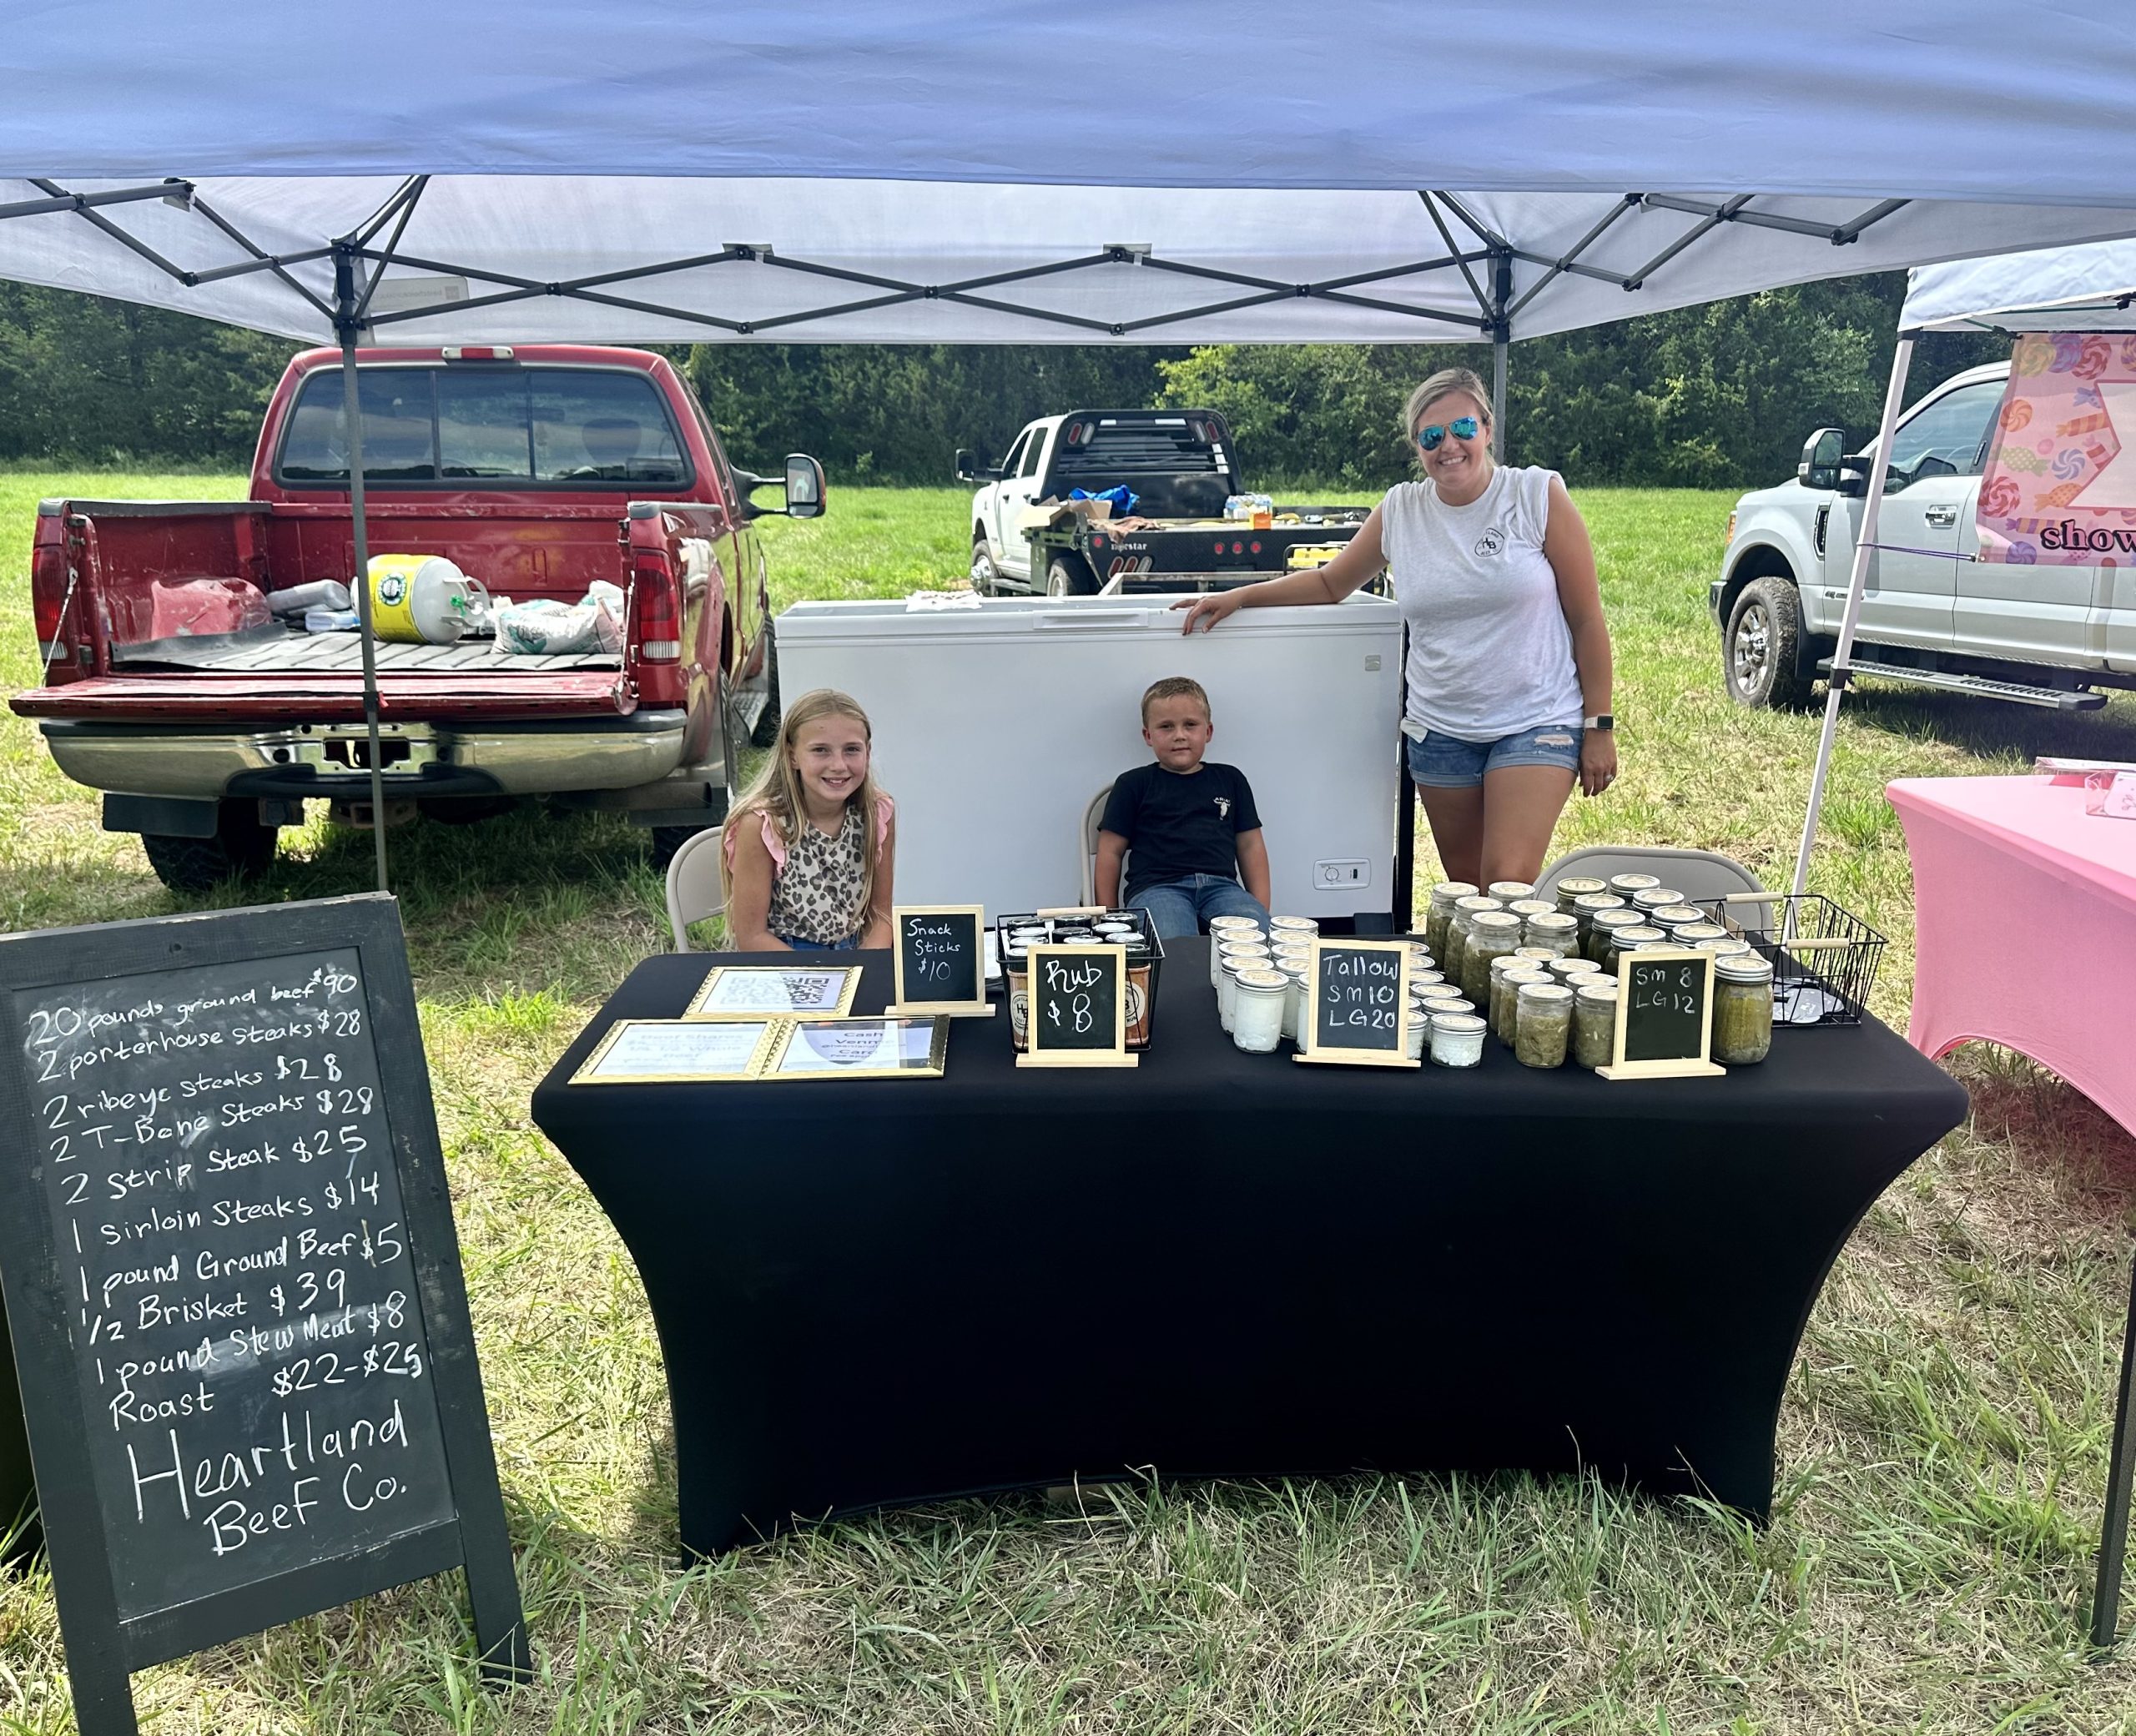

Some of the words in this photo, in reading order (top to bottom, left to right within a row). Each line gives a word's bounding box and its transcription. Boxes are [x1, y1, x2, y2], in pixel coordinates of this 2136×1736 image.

[906, 918, 952, 937] Snack
[914, 938, 961, 956] Sticks
[918, 957, 951, 982] $10
[1045, 959, 1102, 994] Rub
[1322, 954, 1398, 980] Tallow
[1679, 967, 1693, 988] 8
[28, 1008, 82, 1047] 20
[88, 999, 164, 1038] pounds
[173, 989, 257, 1028] ground
[271, 982, 317, 1001] beef
[1673, 993, 1695, 1014] 12
[38, 1049, 62, 1083] 2
[69, 1031, 223, 1080] porterhouse
[317, 1009, 360, 1036] $28
[43, 1094, 75, 1129] 2
[275, 1053, 343, 1082] $28
[50, 1135, 77, 1163] 2
[221, 1094, 305, 1126] Steaks
[316, 1087, 374, 1115] $28
[61, 1173, 91, 1205] 2
[108, 1160, 192, 1200] Strip
[205, 1141, 280, 1172] Steak
[292, 1125, 367, 1163] $25
[73, 1218, 82, 1253] 1
[212, 1195, 314, 1226] Steaks
[325, 1171, 380, 1210] $14
[80, 1266, 89, 1302] 1
[102, 1255, 179, 1309] pound
[196, 1236, 287, 1281] Ground
[296, 1228, 357, 1260] Beef
[360, 1221, 402, 1268] $5
[81, 1307, 124, 1346] 1/2
[138, 1292, 248, 1329] Brisket
[96, 1357, 104, 1385] 1
[115, 1336, 220, 1392] pound
[229, 1325, 294, 1356] Stew
[303, 1303, 355, 1341] Meat
[367, 1291, 406, 1336] $8
[109, 1381, 214, 1432] Roast
[127, 1399, 408, 1524] Heartland
[342, 1463, 406, 1511] Co.
